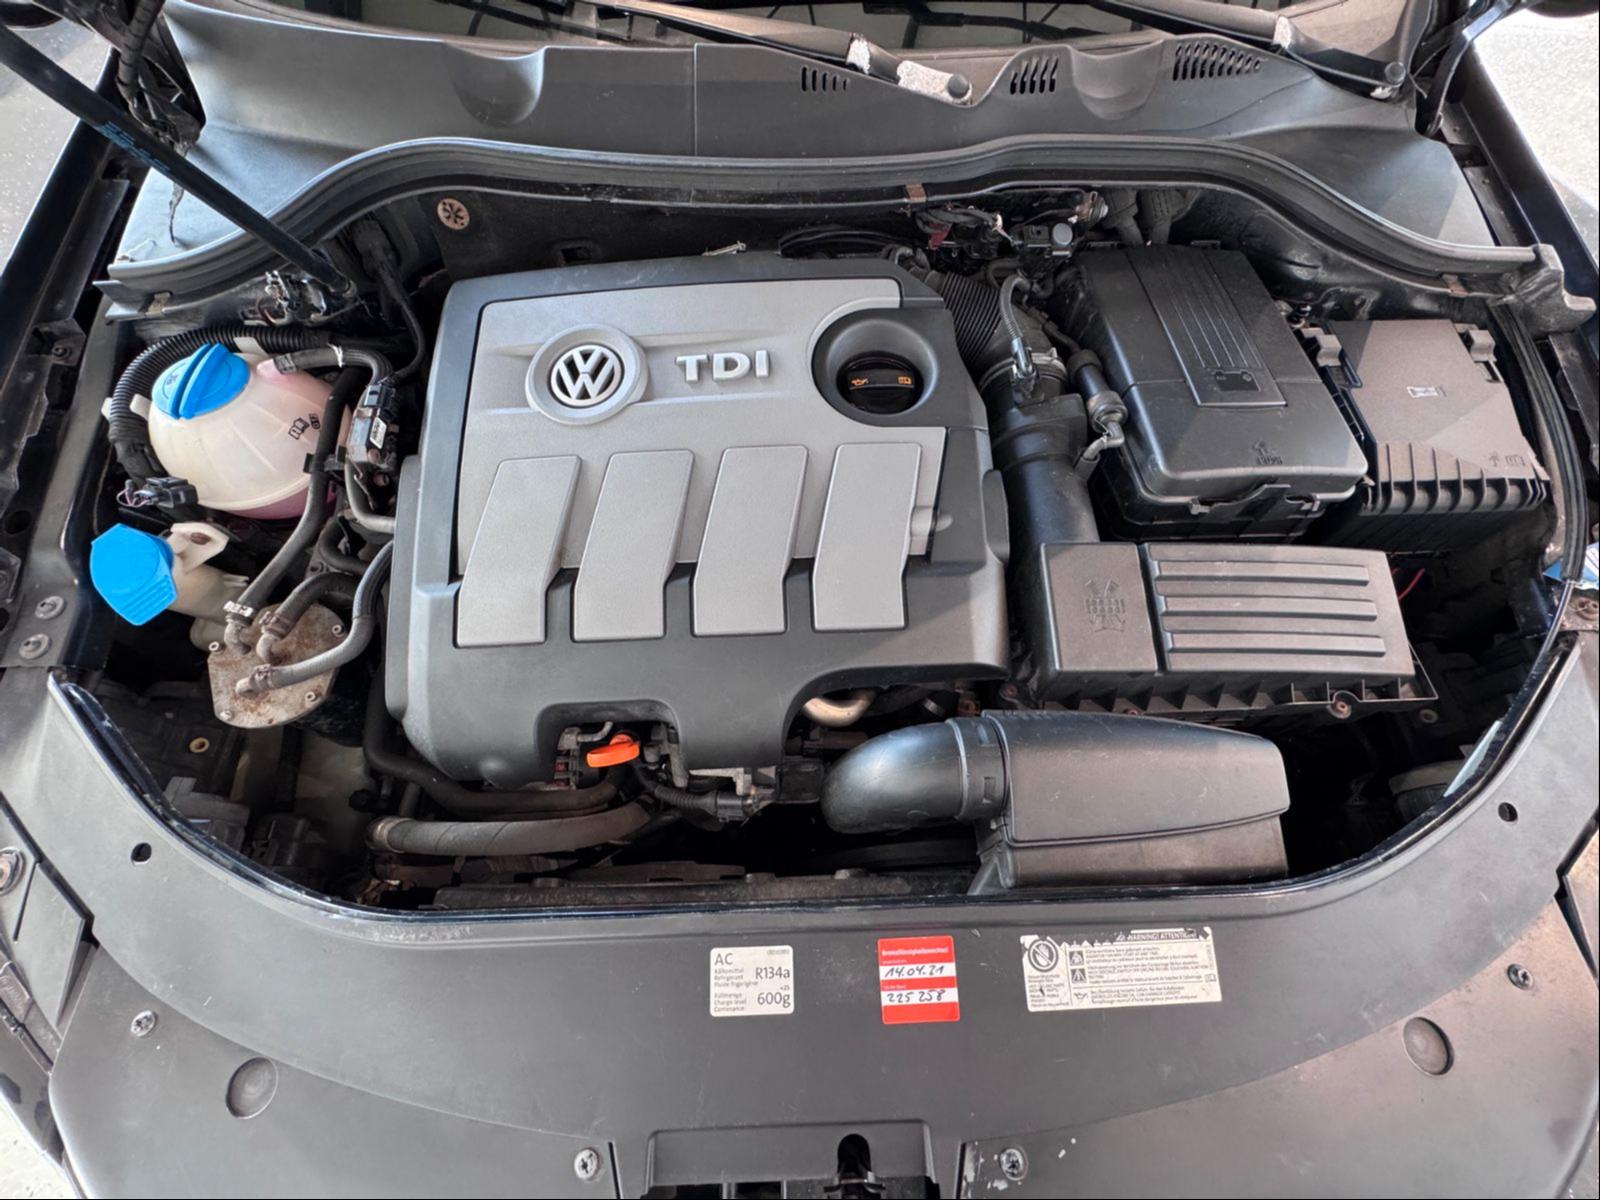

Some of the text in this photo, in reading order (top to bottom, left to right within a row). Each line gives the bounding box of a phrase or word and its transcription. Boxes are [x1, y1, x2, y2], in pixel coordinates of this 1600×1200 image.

[676, 349, 770, 385] TDI
[550, 344, 622, 407] VW
[714, 953, 734, 966] AC
[755, 966, 790, 980] R134a
[884, 964, 945, 978] 14.04.21
[757, 992, 791, 1009] 600g
[887, 991, 914, 1004] 225
